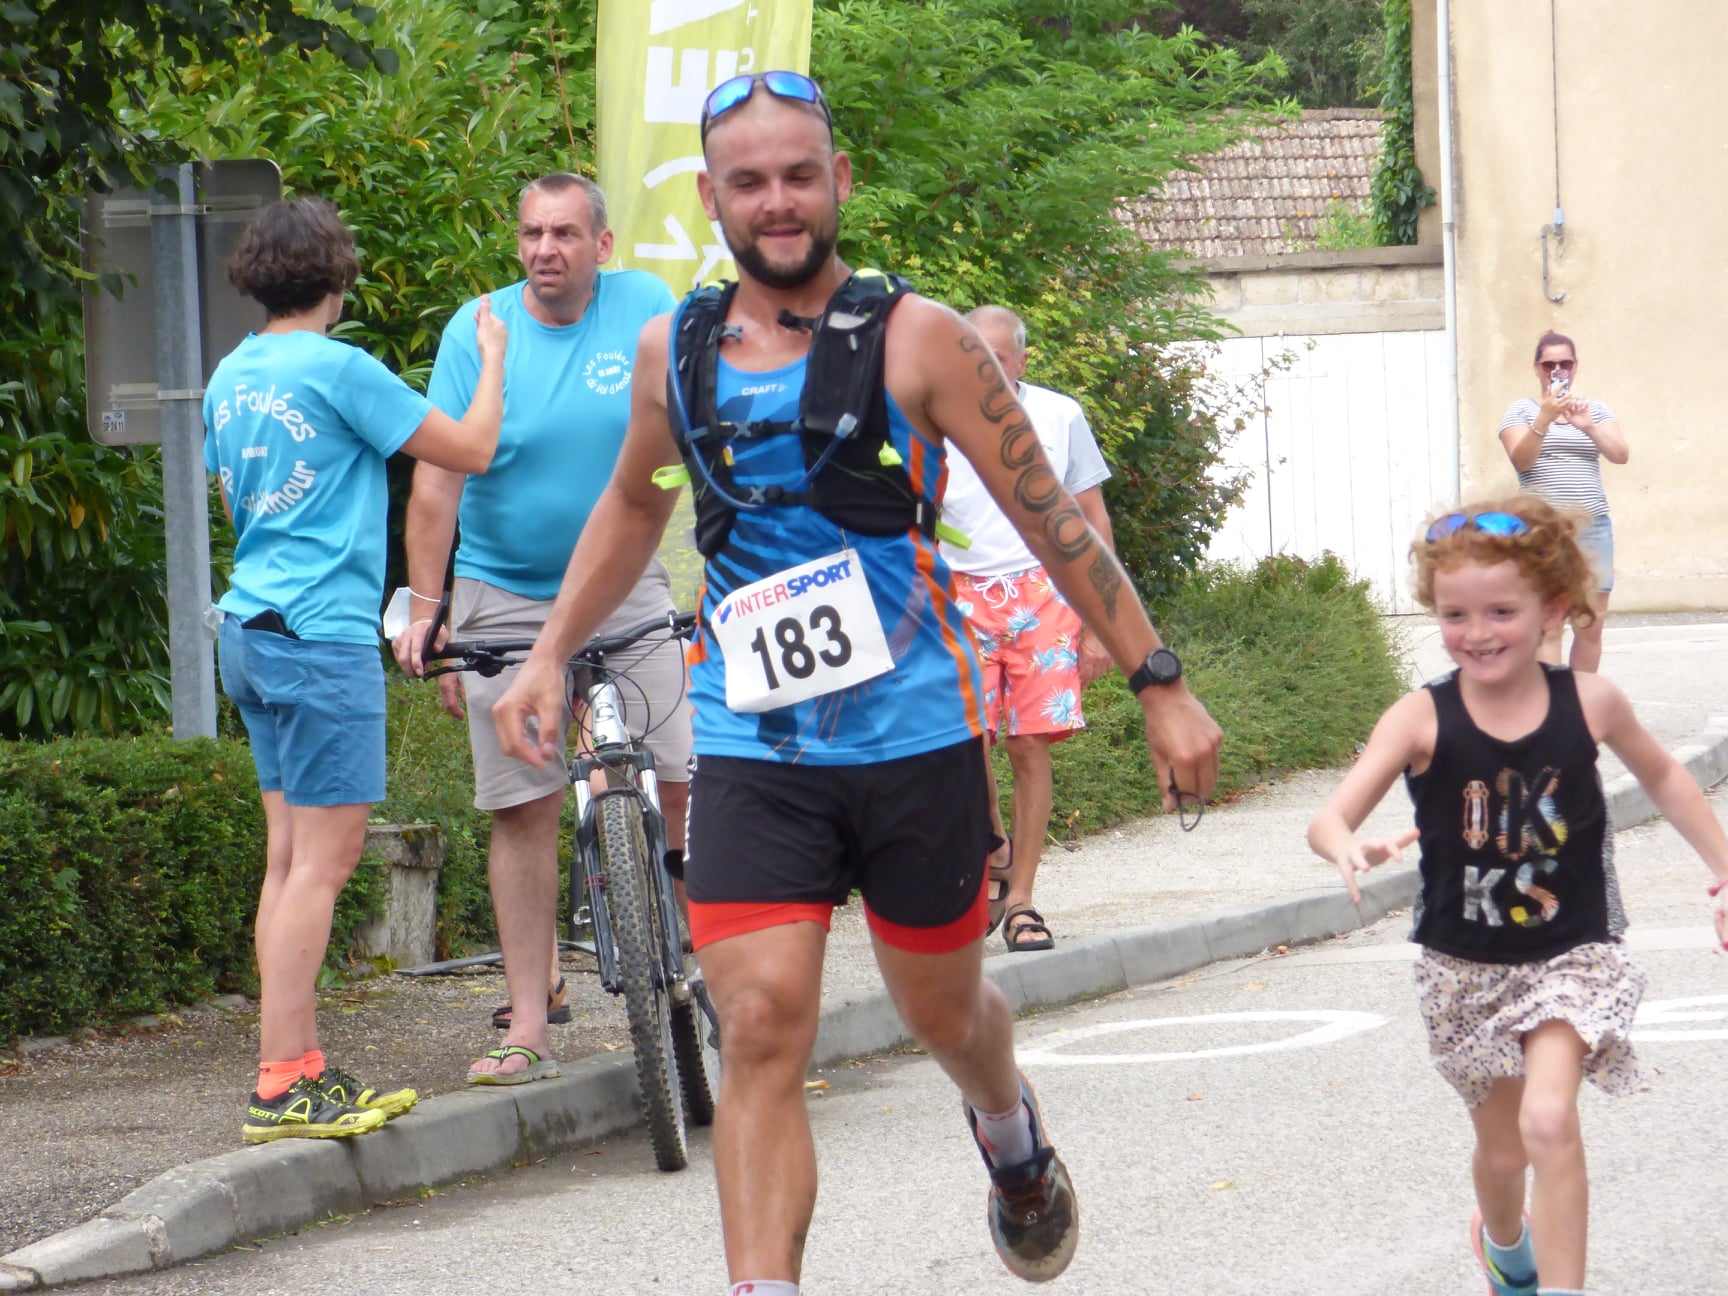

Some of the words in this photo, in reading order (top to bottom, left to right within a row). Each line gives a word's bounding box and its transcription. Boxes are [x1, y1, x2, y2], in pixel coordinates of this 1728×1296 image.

[234, 383, 317, 443] Foulées
[741, 383, 777, 396] CRAFT
[733, 559, 852, 618] INTERSPORT
[751, 604, 853, 691] 183
[1462, 858, 1560, 928] KS
[247, 1106, 280, 1121] SCOTT
